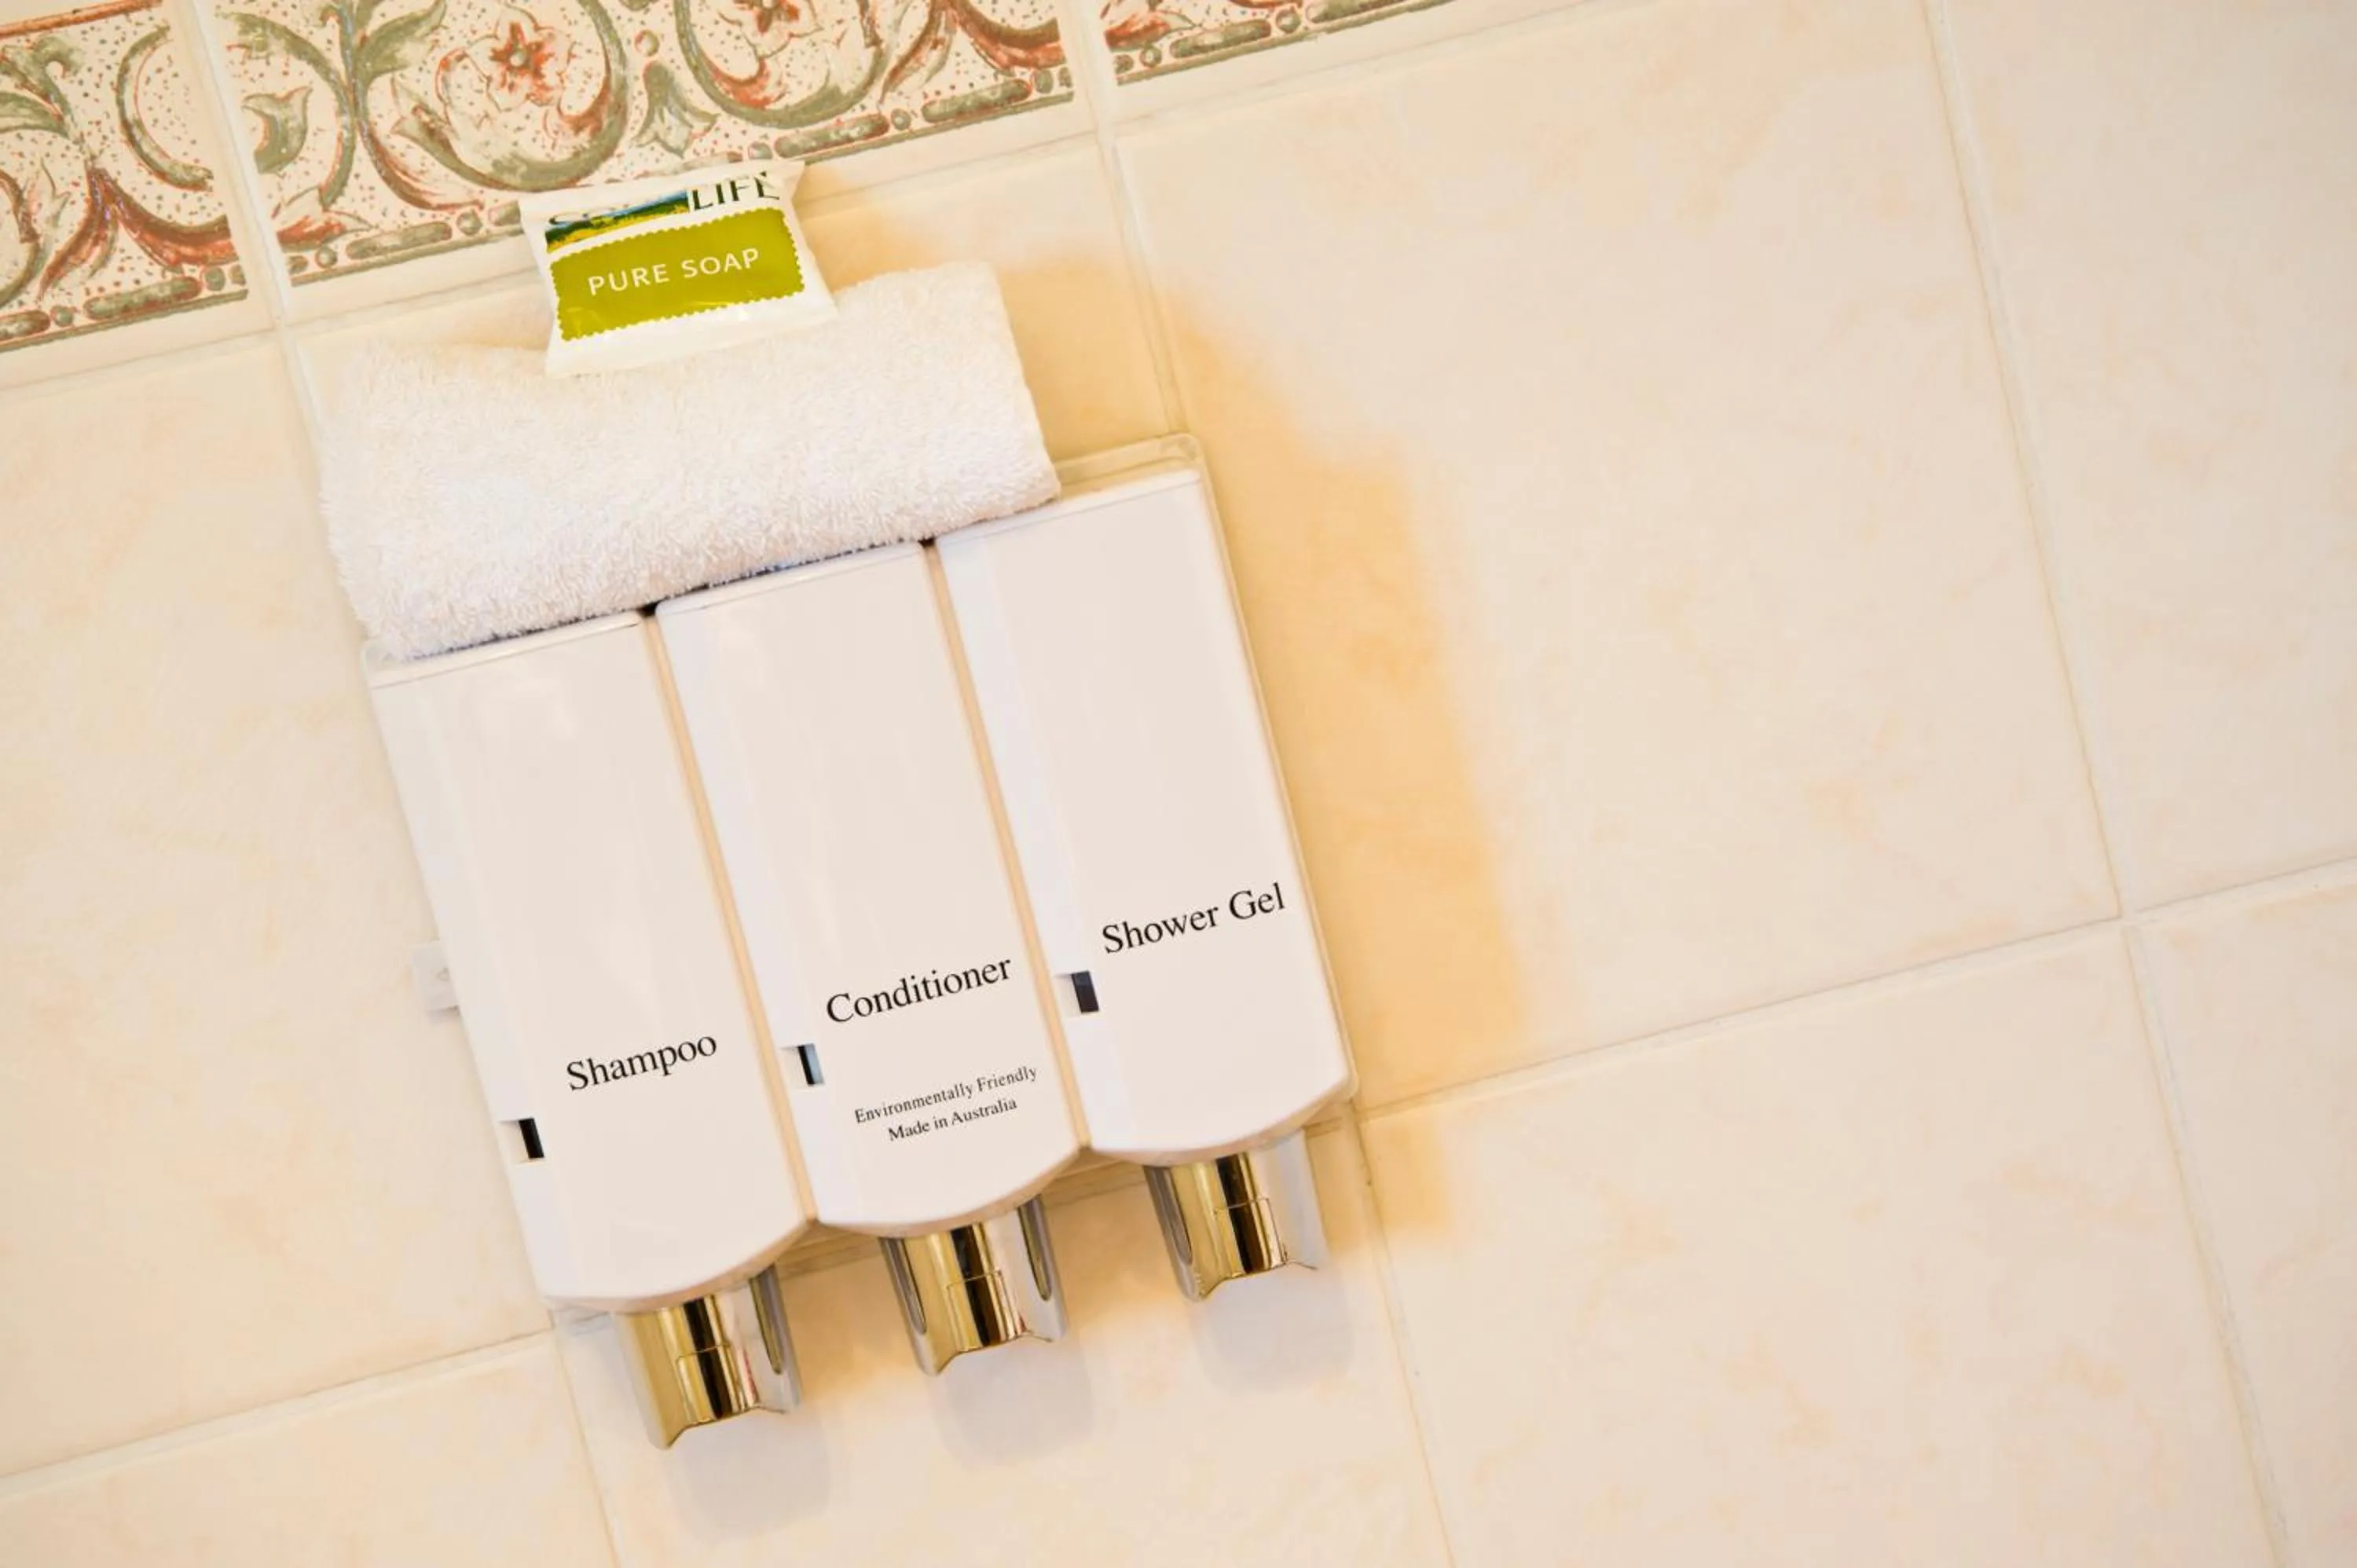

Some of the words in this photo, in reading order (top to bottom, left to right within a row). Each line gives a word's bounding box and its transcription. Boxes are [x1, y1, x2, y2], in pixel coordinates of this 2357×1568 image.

[588, 263, 669, 295] PURE
[681, 248, 759, 278] SOAP
[1102, 906, 1219, 954] Shower
[1228, 881, 1285, 920] Gel
[826, 958, 1012, 1023] Conditioner
[566, 1035, 717, 1091] Shampoo
[854, 1083, 973, 1123] Environmentally
[975, 1065, 1038, 1092] Friendly
[888, 1118, 929, 1141] Made
[934, 1118, 948, 1130] in
[951, 1099, 1017, 1126] Australia
